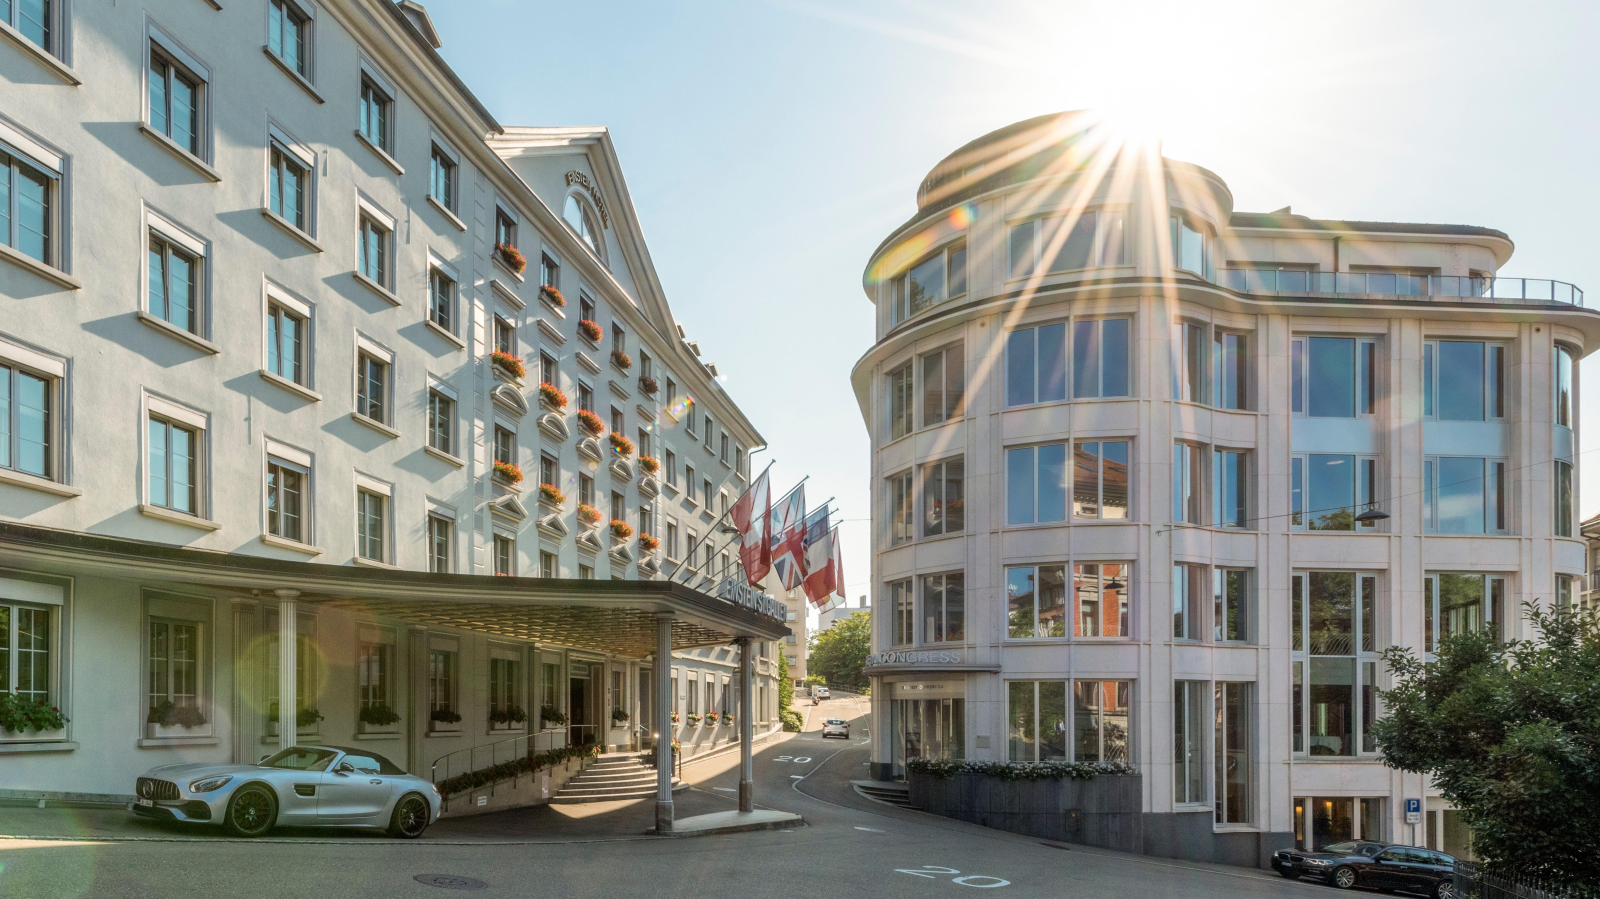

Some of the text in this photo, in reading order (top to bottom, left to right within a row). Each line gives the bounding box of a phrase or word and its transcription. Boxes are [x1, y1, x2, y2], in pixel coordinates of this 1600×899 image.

[565, 169, 591, 191] EINSTEIN
[721, 576, 757, 610] EINSTEIN
[880, 651, 960, 664] CONGRESS
[1411, 801, 1417, 811] P
[893, 865, 1011, 888] 20
